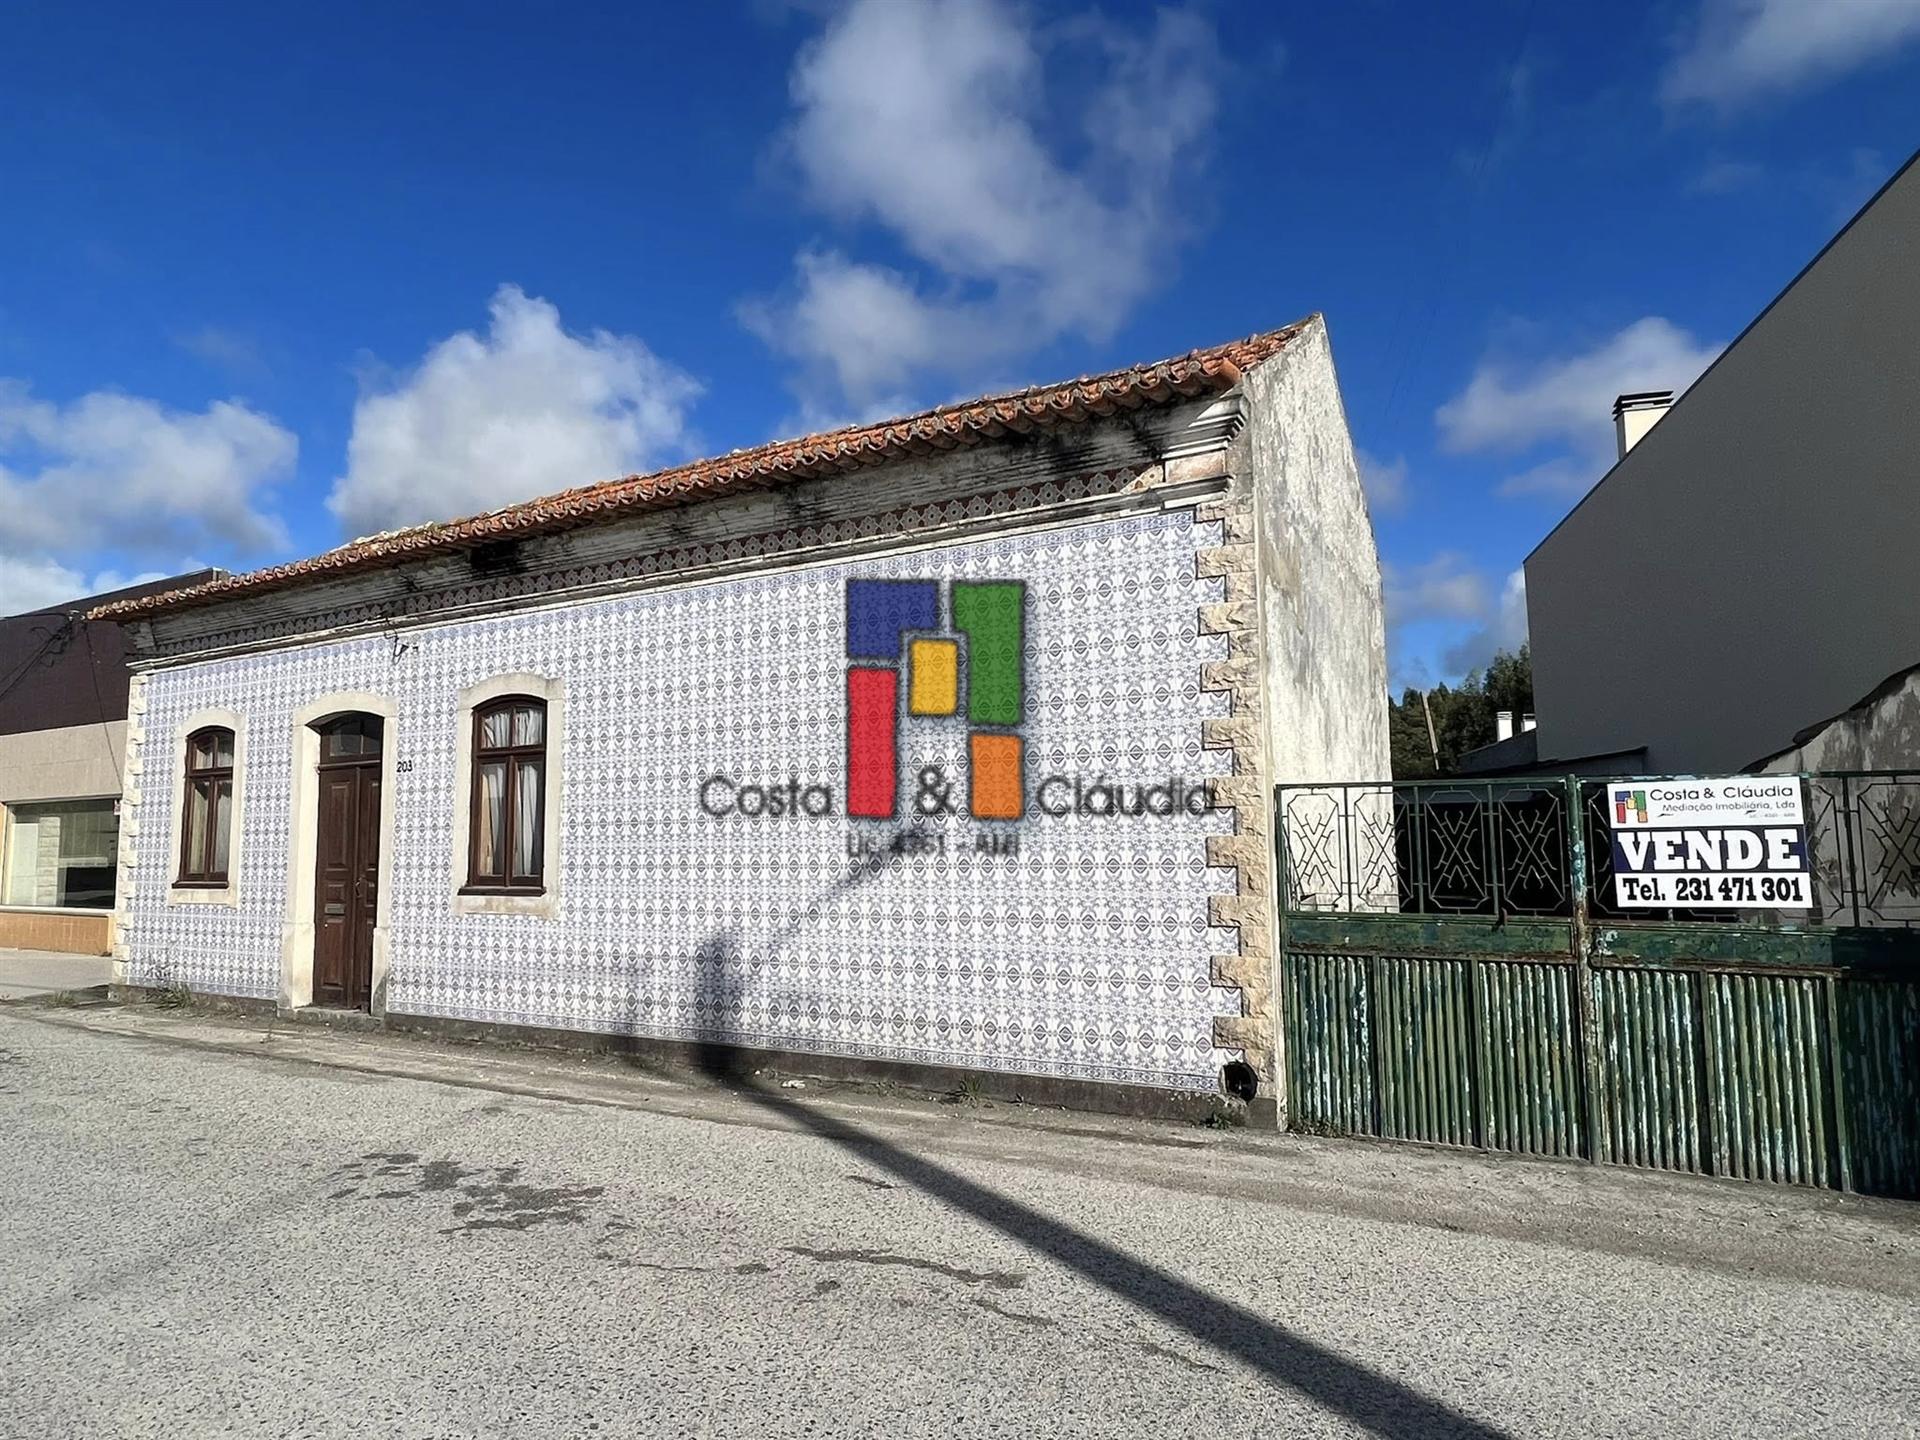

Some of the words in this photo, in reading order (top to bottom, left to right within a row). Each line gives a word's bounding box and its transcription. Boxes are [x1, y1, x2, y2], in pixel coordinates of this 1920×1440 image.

[396, 760, 413, 773] 203
[1650, 789, 1699, 801] Costa
[1704, 787, 1715, 799] &
[1723, 785, 1793, 798] Cláudia
[1662, 803, 1713, 813] Mediação
[1776, 800, 1795, 810] Lda
[1617, 829, 1801, 870] VENDE
[1622, 877, 1666, 901] Tel.
[1675, 877, 1714, 901] 231
[1718, 877, 1757, 901] 471
[1762, 877, 1803, 901] 301
